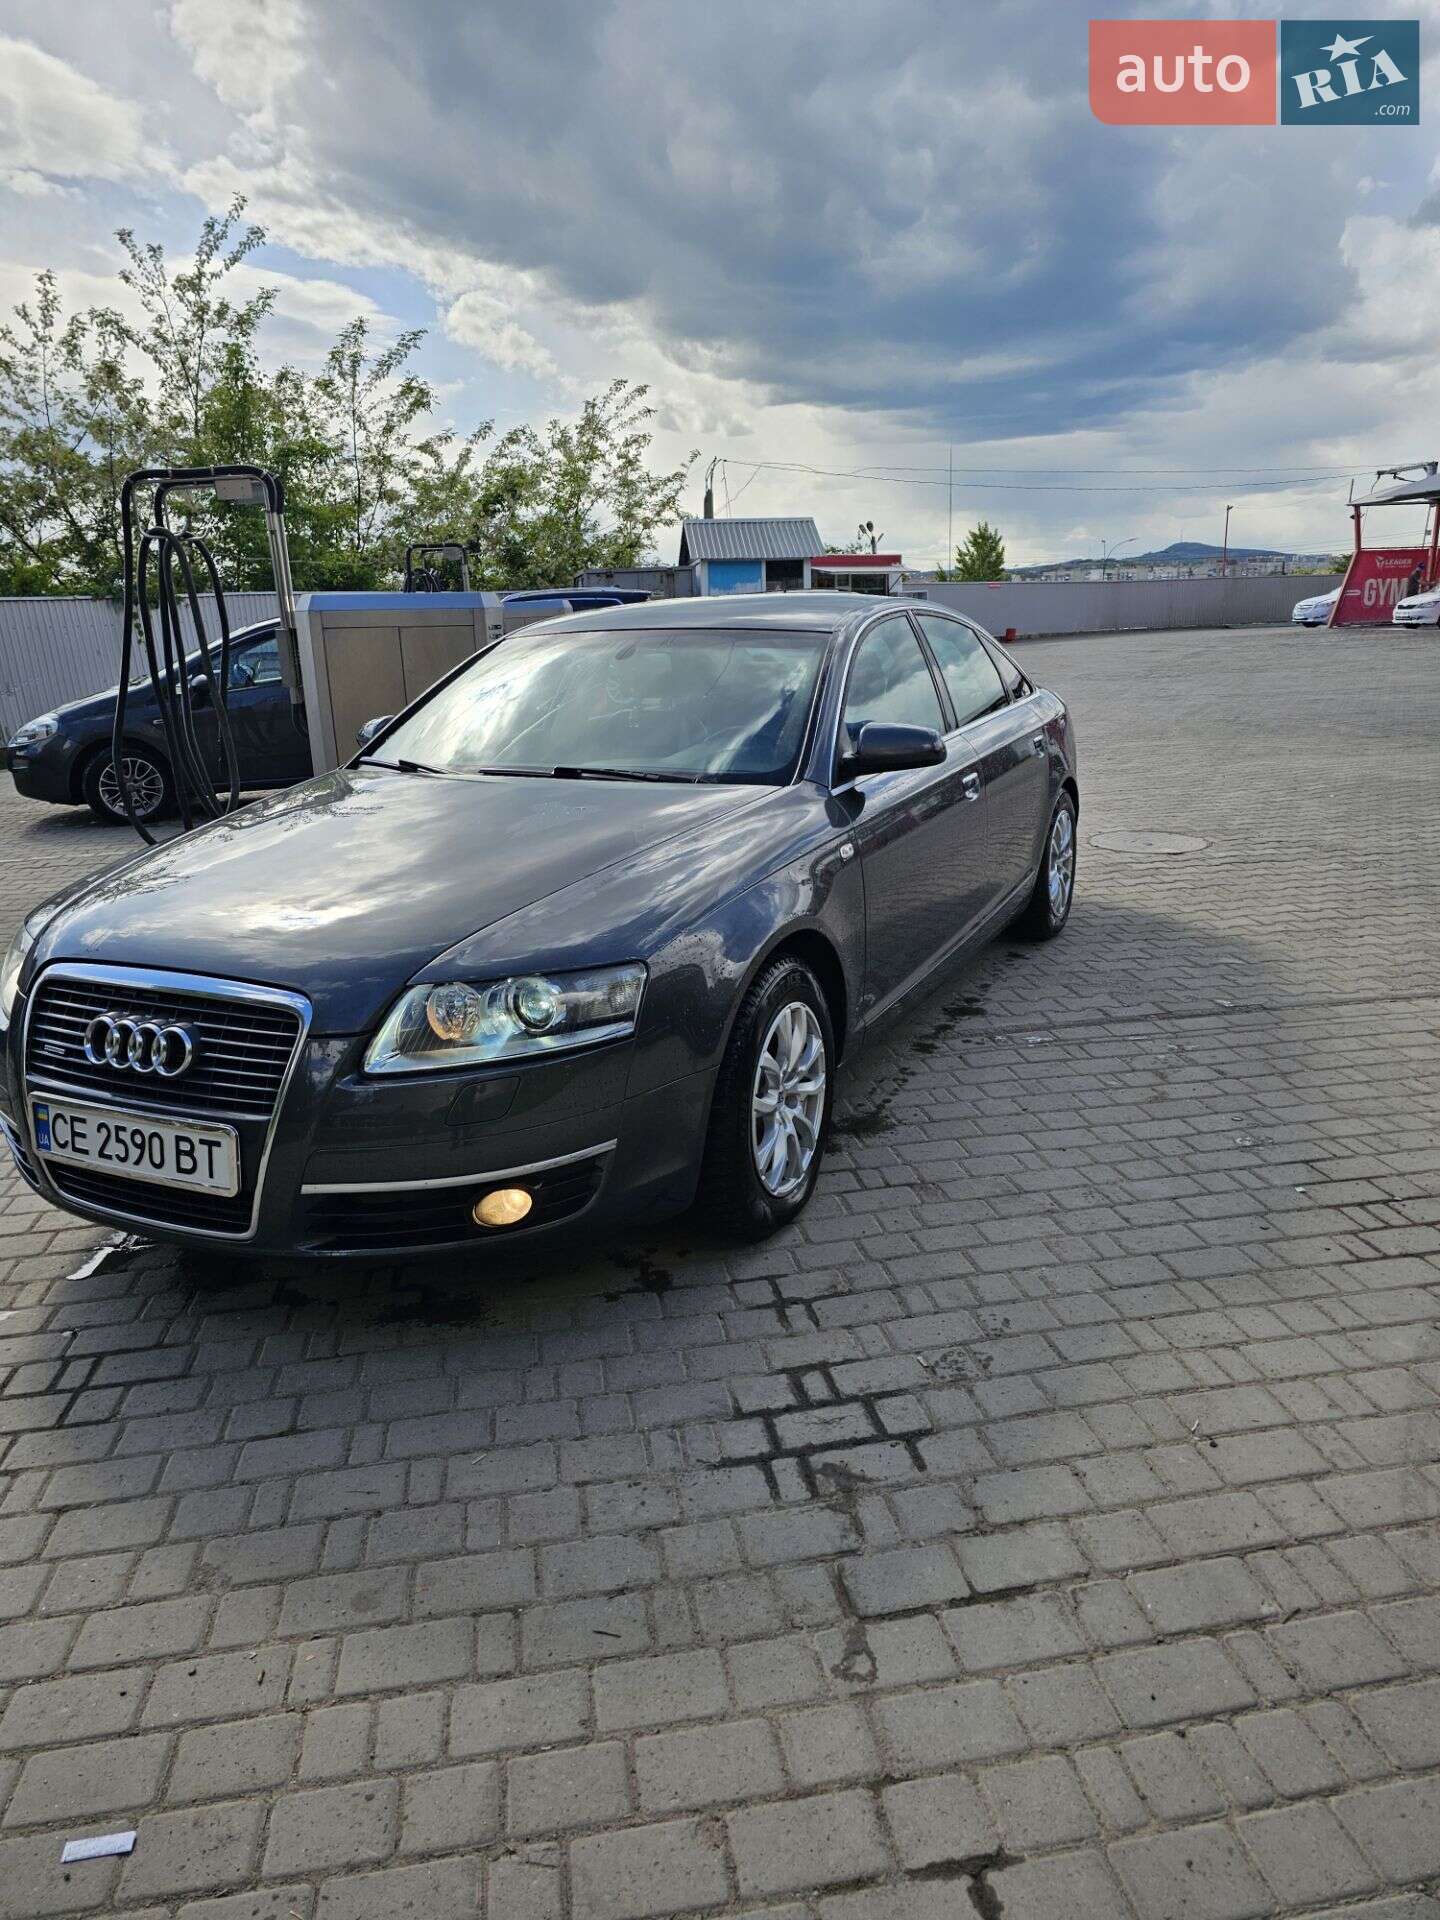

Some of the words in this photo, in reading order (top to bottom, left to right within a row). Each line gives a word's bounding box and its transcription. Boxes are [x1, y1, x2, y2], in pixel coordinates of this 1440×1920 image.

[1363, 578, 1409, 607] GYM
[38, 1131, 50, 1146] UA
[52, 1113, 89, 1156] CE
[96, 1122, 165, 1169] 2590
[175, 1135, 222, 1179] BT
